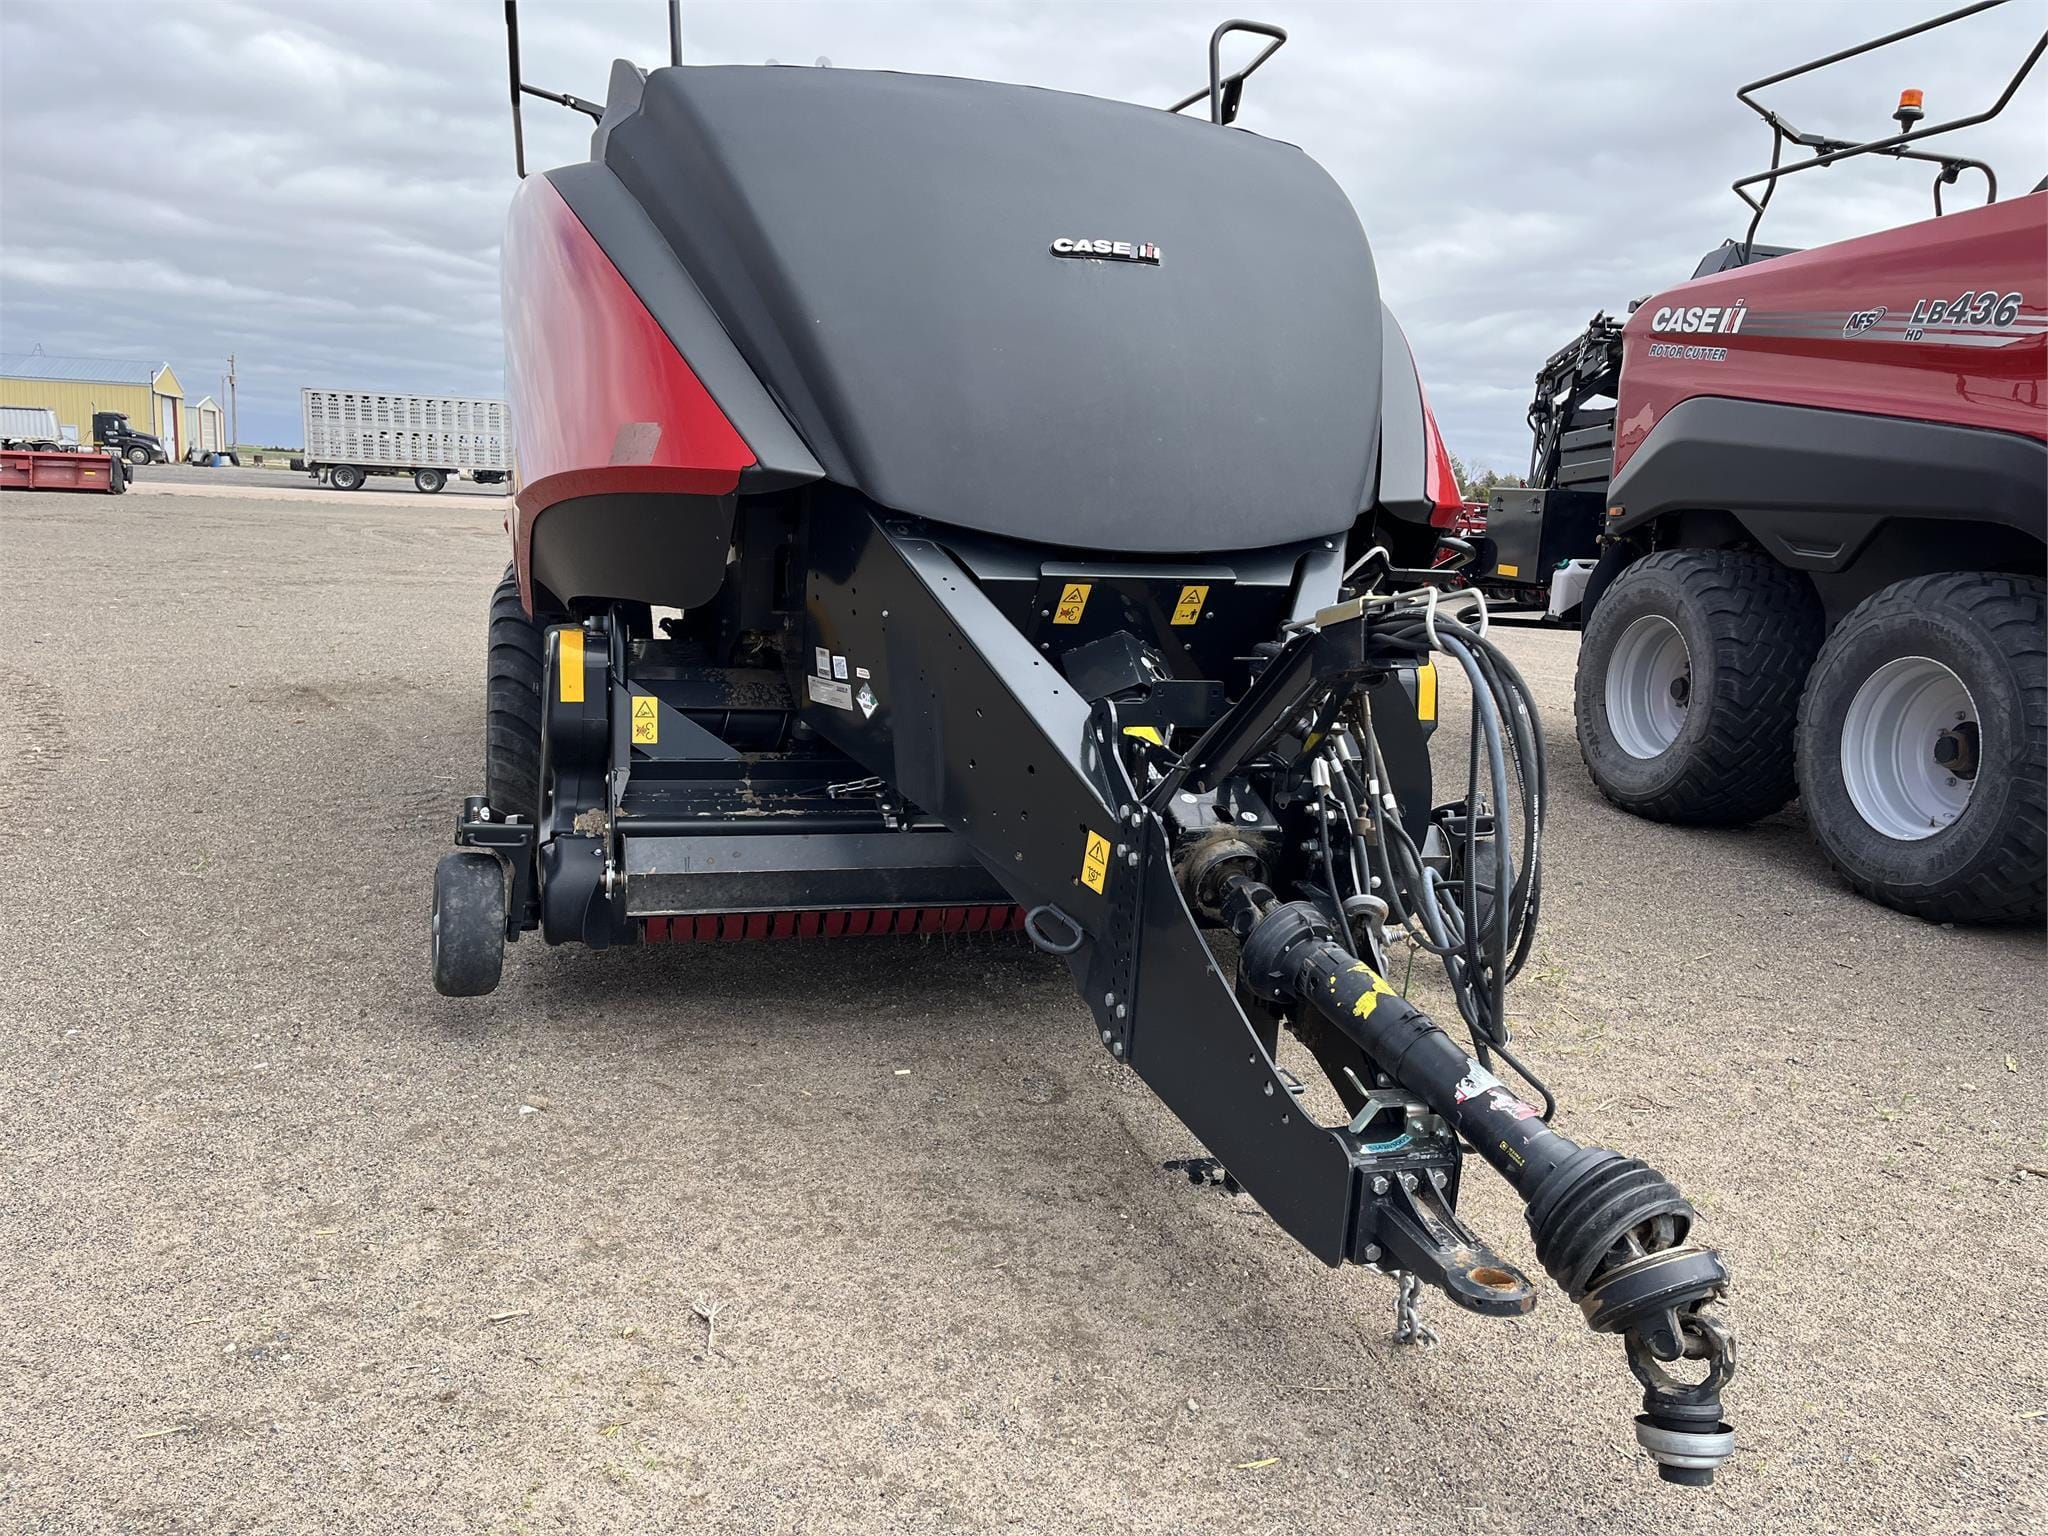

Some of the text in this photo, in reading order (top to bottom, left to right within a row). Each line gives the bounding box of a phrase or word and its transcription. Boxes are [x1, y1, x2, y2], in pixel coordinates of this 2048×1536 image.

[1053, 238, 1131, 255] CASE
[1909, 291, 2023, 327] LB436
[1652, 307, 1721, 333] CASE
[1843, 311, 1877, 331] AFS
[1904, 328, 1924, 342] HD
[1649, 344, 1728, 361] ROTOR CUTTER
